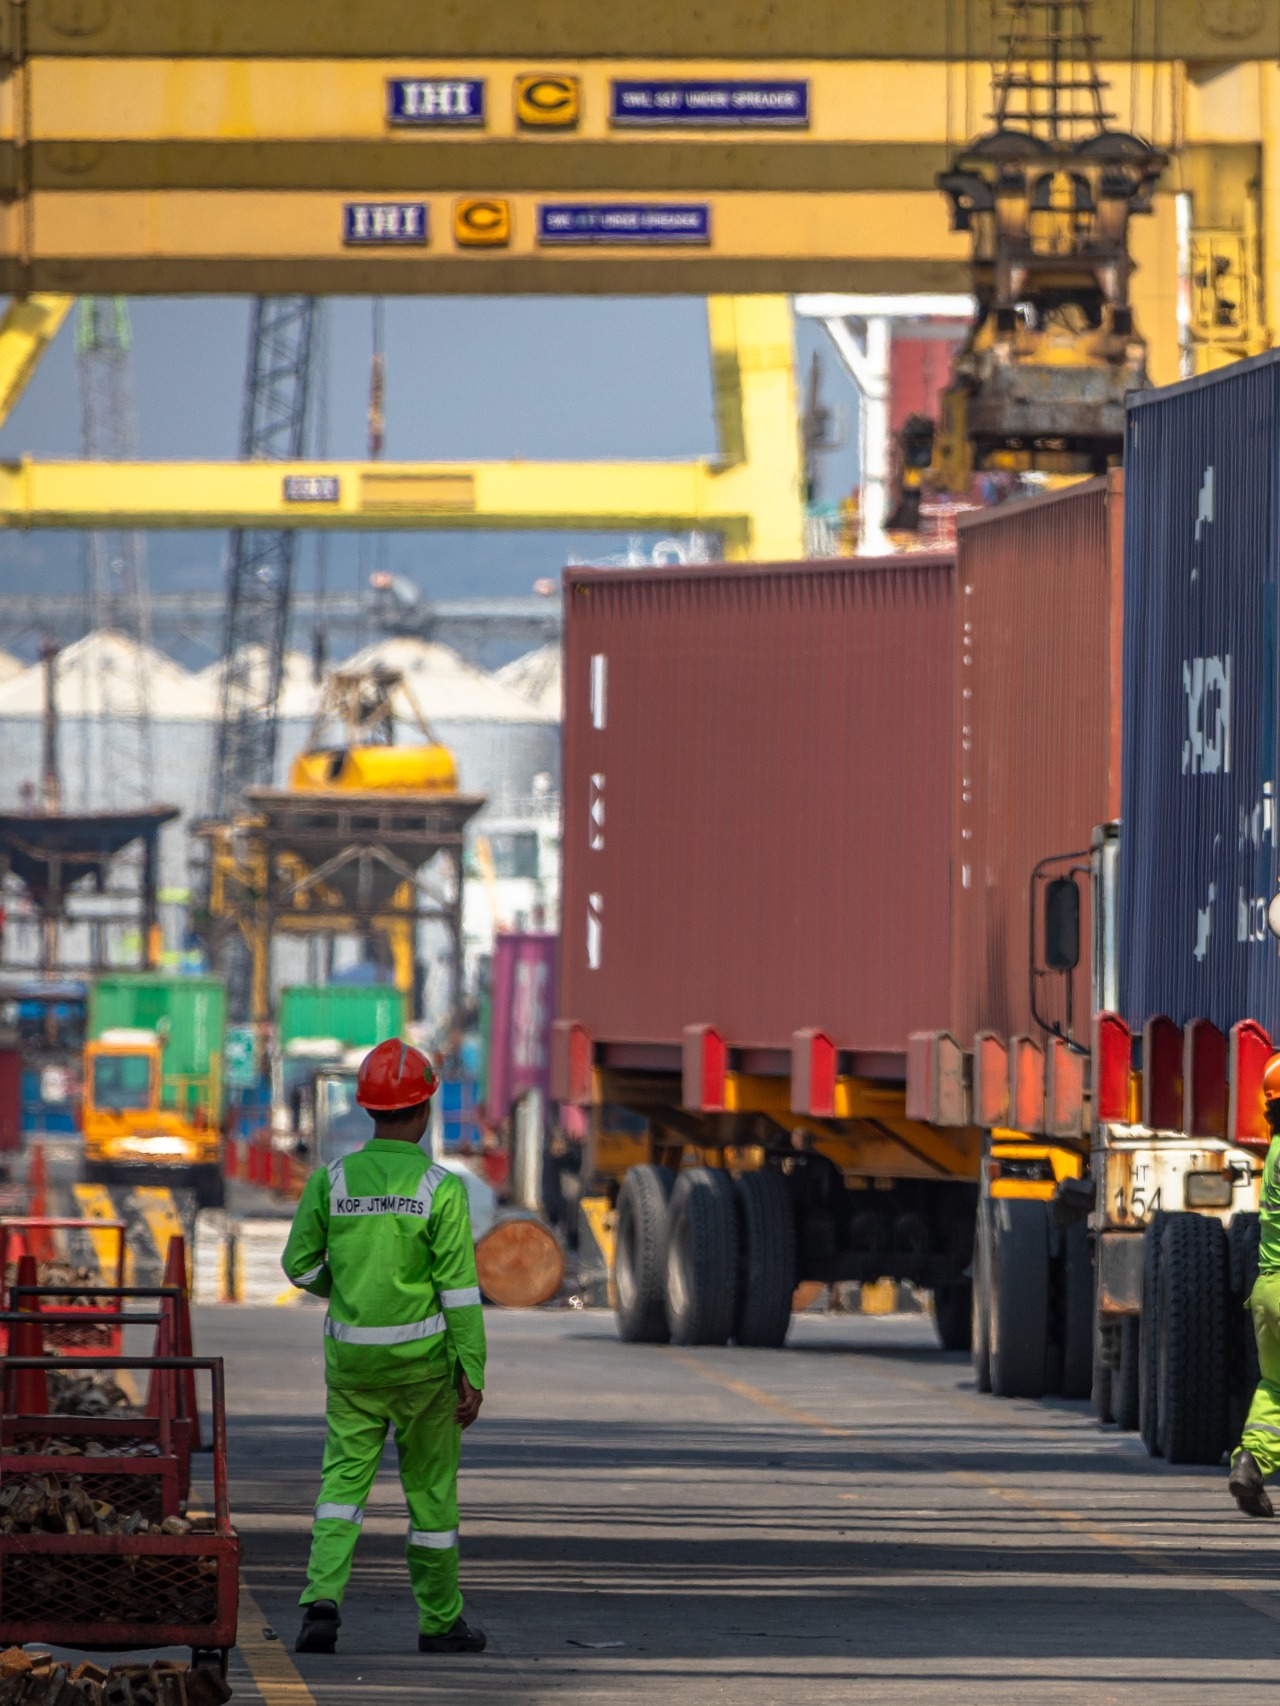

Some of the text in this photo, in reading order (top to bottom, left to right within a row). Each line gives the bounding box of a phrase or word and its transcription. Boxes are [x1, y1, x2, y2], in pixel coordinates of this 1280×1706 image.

[402, 82, 474, 116] IHI
[685, 90, 728, 109] UNDER
[731, 90, 798, 109] SPREADER
[352, 206, 420, 237] IHI
[336, 1198, 364, 1213] KOP.
[397, 1197, 424, 1215] PTES
[1114, 1186, 1162, 1218] 154
